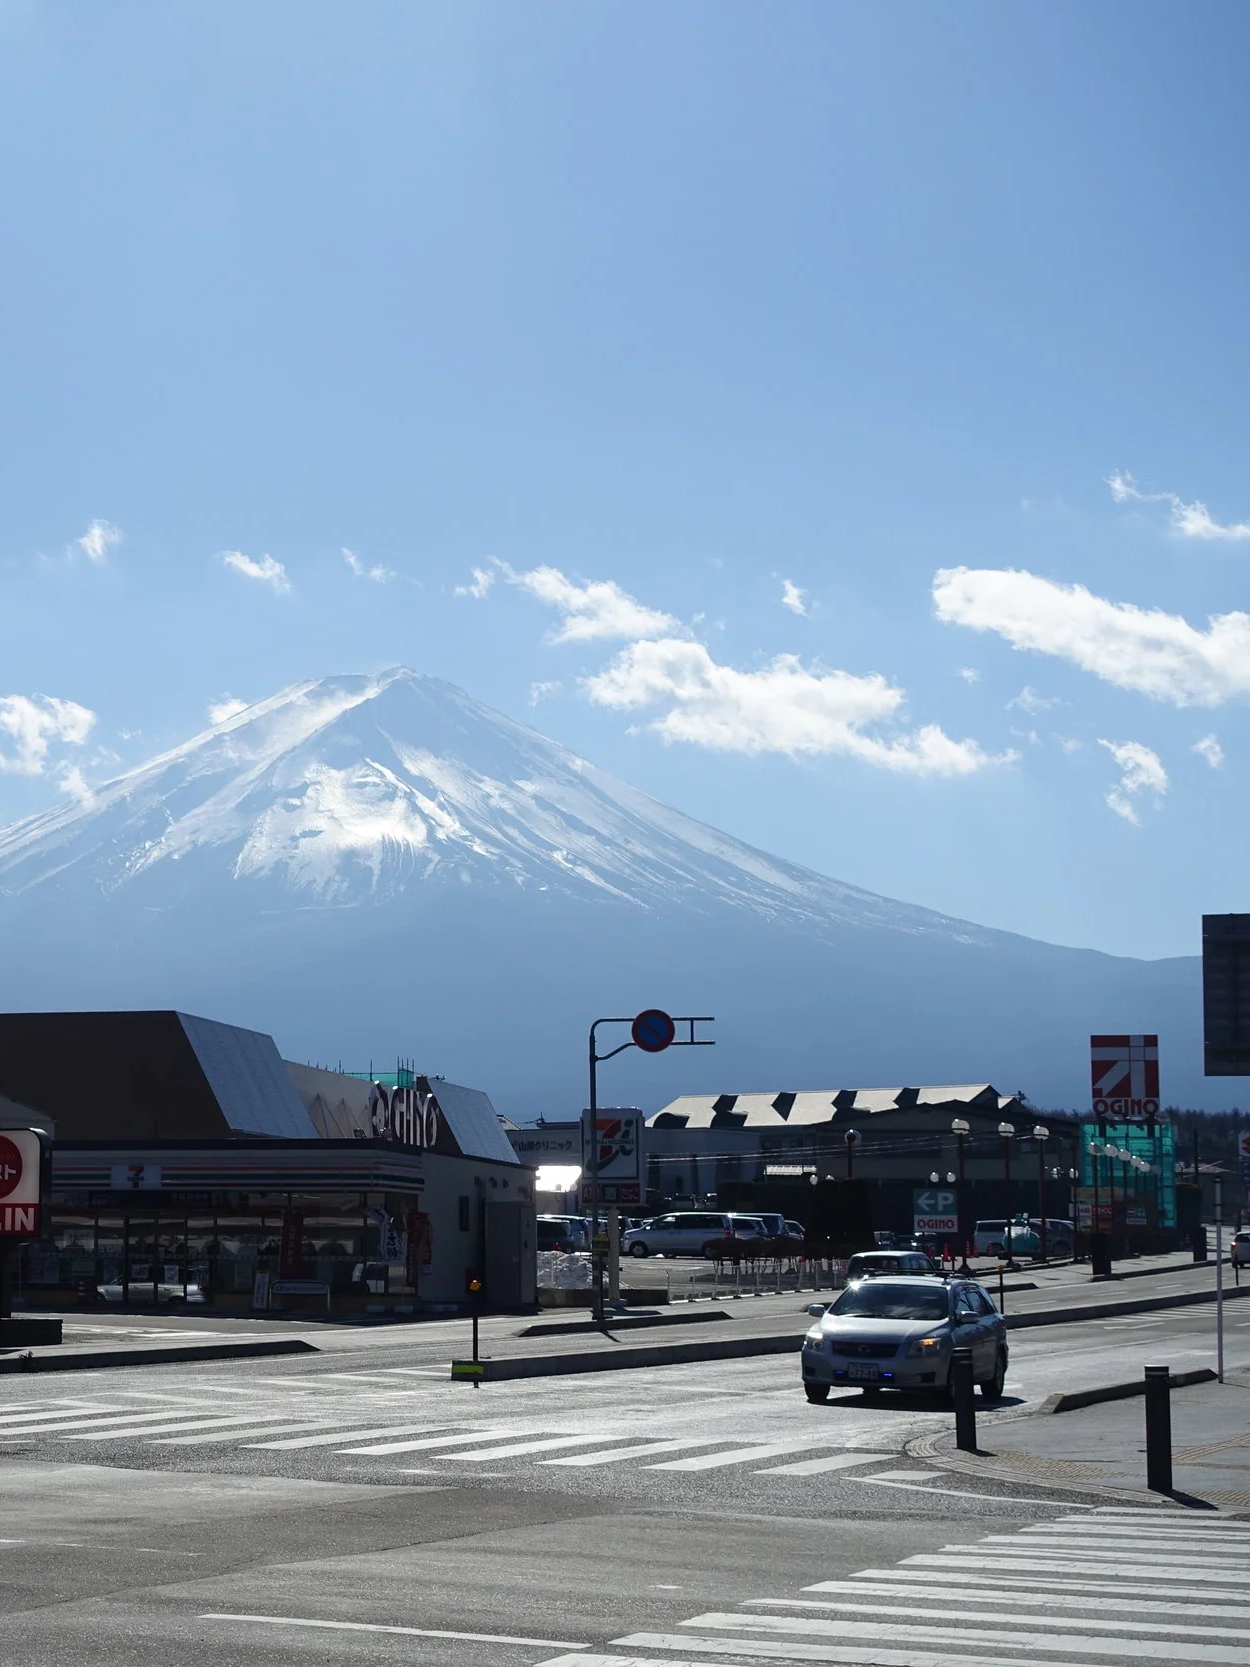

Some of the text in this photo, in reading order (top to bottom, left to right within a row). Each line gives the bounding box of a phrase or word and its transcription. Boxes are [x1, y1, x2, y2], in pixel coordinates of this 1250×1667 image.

[1093, 1098, 1159, 1115] OGINO
[937, 1192, 955, 1211] P
[4, 1207, 35, 1232] IN
[917, 1219, 955, 1229] OGINO
